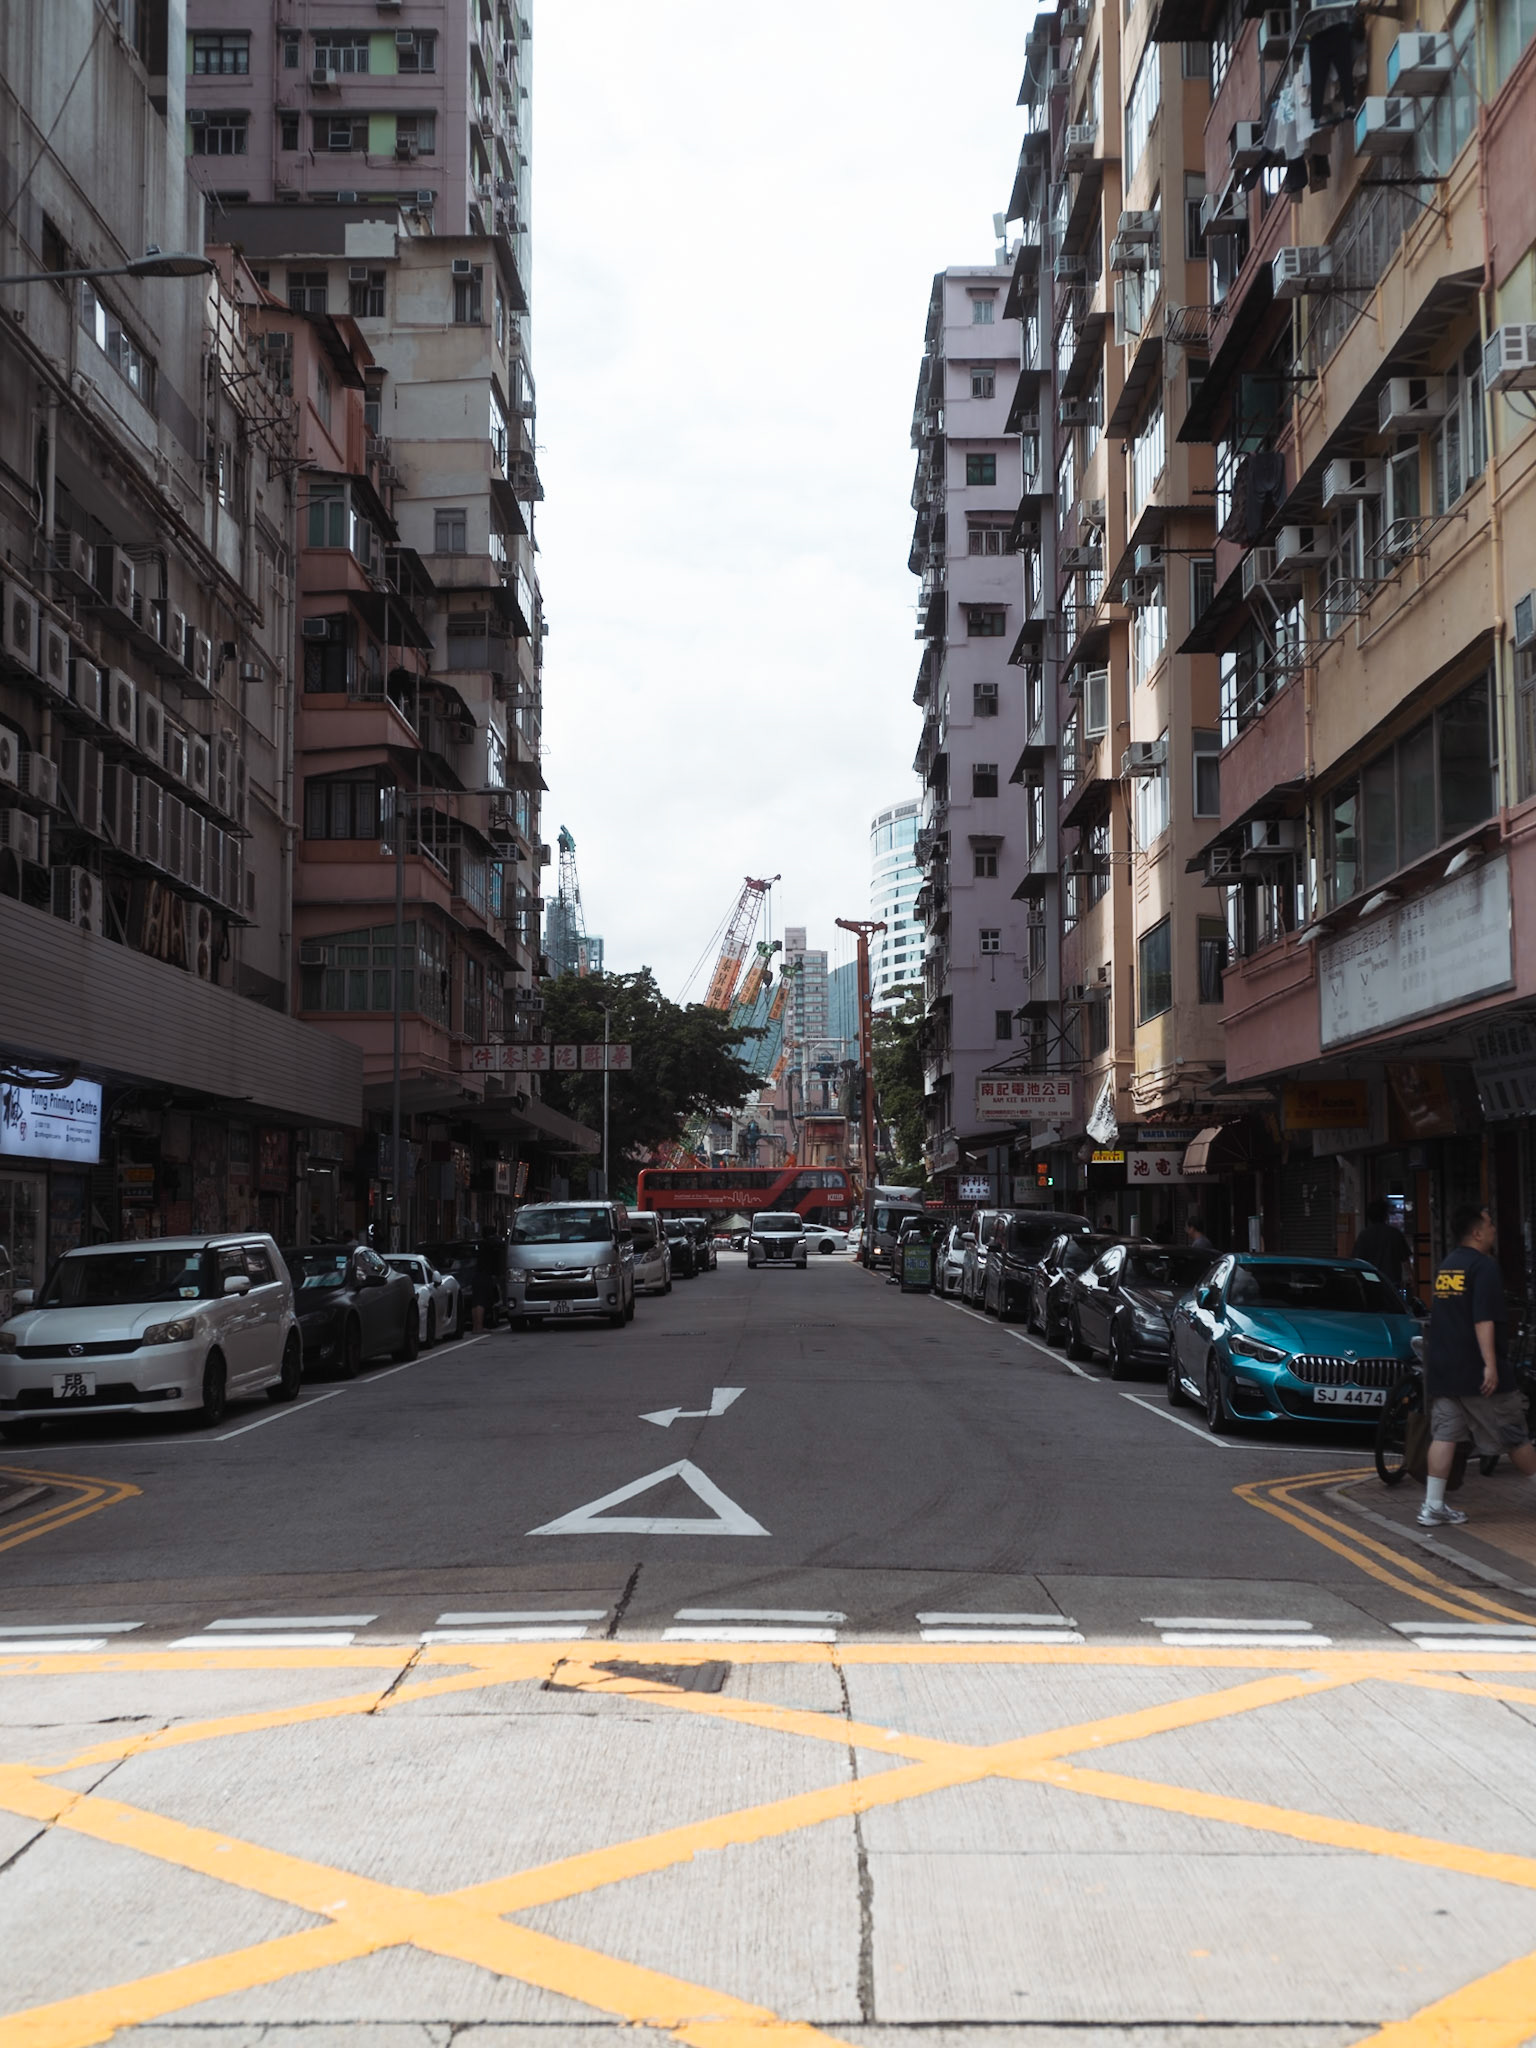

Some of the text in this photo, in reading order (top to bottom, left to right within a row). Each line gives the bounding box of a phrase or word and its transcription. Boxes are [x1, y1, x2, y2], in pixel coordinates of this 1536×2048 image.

[981, 1082, 1070, 1096] 南記電池公司
[31, 1089, 98, 1116] Fung Printing Centre
[827, 1193, 844, 1201] KMB
[886, 1194, 912, 1202] FedEx
[65, 1373, 82, 1386] EB
[60, 1385, 87, 1398] 728
[1317, 1389, 1383, 1405] SJ 4474
